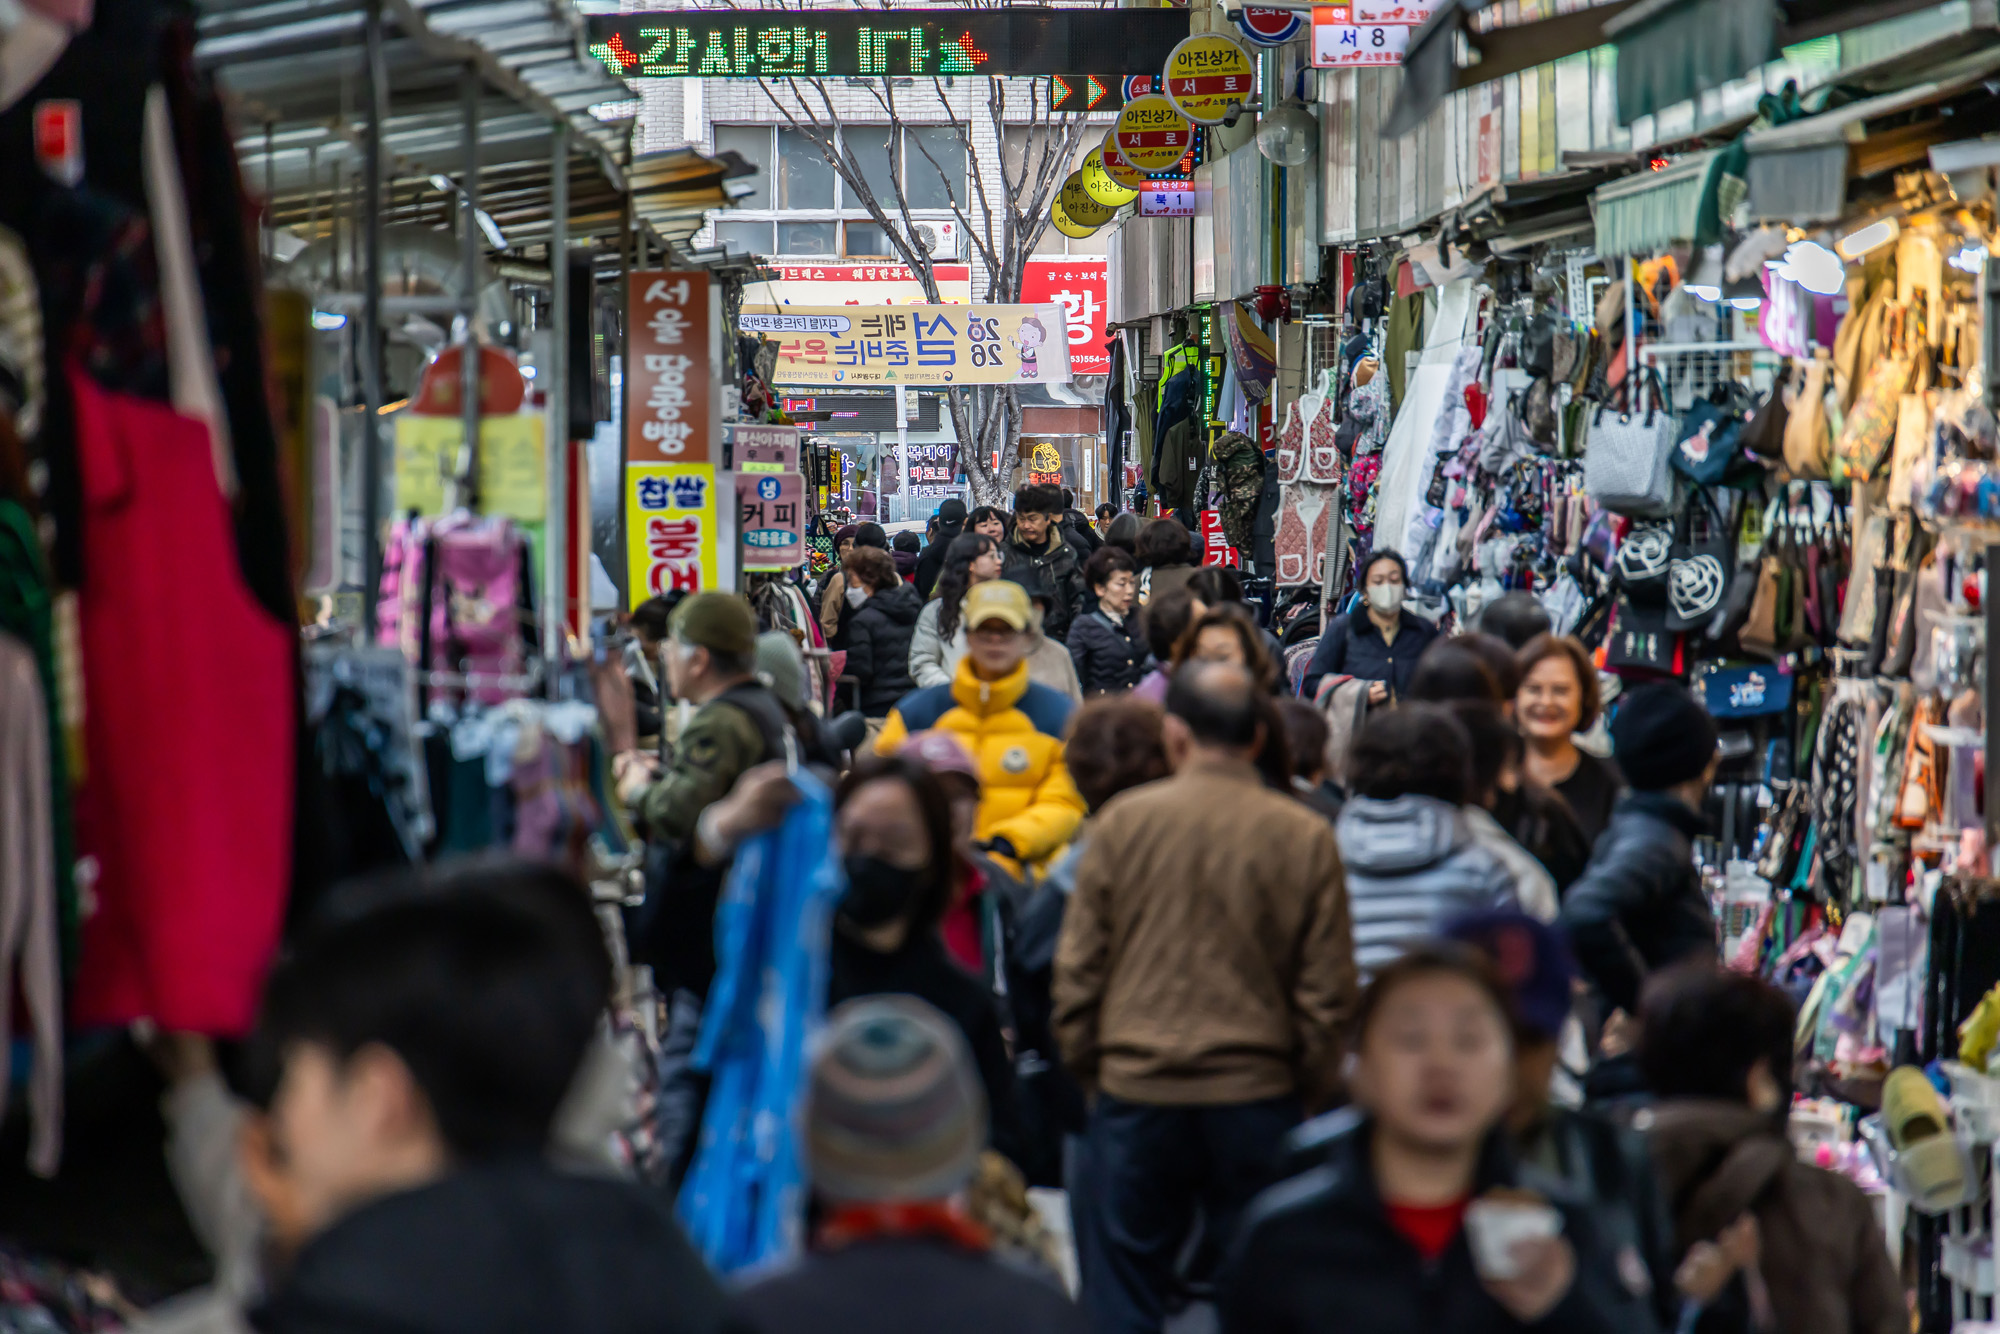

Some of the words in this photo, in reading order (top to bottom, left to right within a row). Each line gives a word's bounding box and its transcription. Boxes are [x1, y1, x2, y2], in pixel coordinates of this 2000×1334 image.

[1340, 29, 1357, 47] 서
[1372, 28, 1385, 47] 8
[1178, 49, 1239, 68] 아진상가
[1126, 109, 1179, 124] 아진상가
[1152, 181, 1189, 189] 아진상가
[1156, 193, 1167, 205] 북
[1176, 193, 1182, 205] 1
[643, 279, 693, 345] 서울
[1050, 289, 1101, 345] 황
[641, 354, 694, 456] 땅콩빵
[637, 475, 707, 510] 찹쌀
[761, 480, 777, 500] 냉
[897, 484, 949, 500] 타로크
[743, 501, 796, 528] 커피
